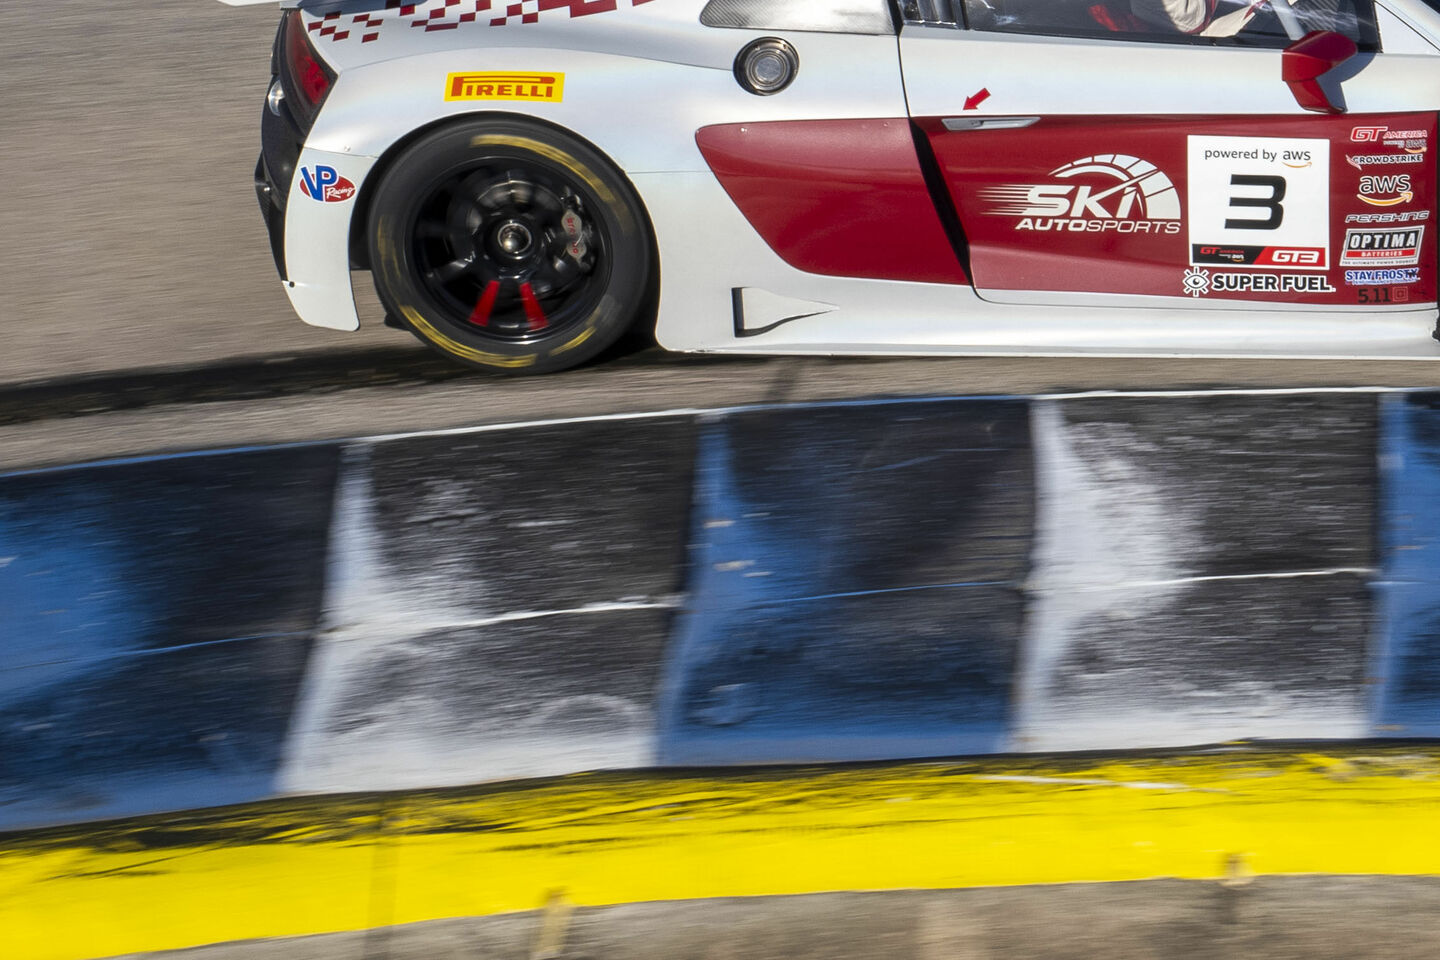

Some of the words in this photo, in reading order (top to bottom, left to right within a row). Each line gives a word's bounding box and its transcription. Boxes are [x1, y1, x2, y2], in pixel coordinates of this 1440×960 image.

[451, 76, 555, 98] PIRELLI
[1351, 126, 1388, 142] GT
[1204, 149, 1259, 161] powered
[1263, 149, 1278, 163] by
[1282, 150, 1312, 161] aws
[1352, 154, 1424, 165] CROWDSTRIKE
[301, 165, 338, 202] VP
[326, 186, 356, 200] Racing
[1359, 174, 1412, 194] aws
[1022, 184, 1138, 219] SKI
[1224, 173, 1287, 231] 3
[1345, 210, 1430, 224] PERSHING
[1015, 218, 1181, 234] AUTOSPORTS
[1350, 232, 1416, 249] OPTIMA
[1272, 250, 1320, 263] GT3
[1361, 250, 1403, 258] BATTERIES
[1213, 274, 1278, 290] SUPER
[1345, 271, 1373, 281] STAY
[1375, 267, 1419, 280] FROSTY
[1358, 288, 1390, 303] 5.11
